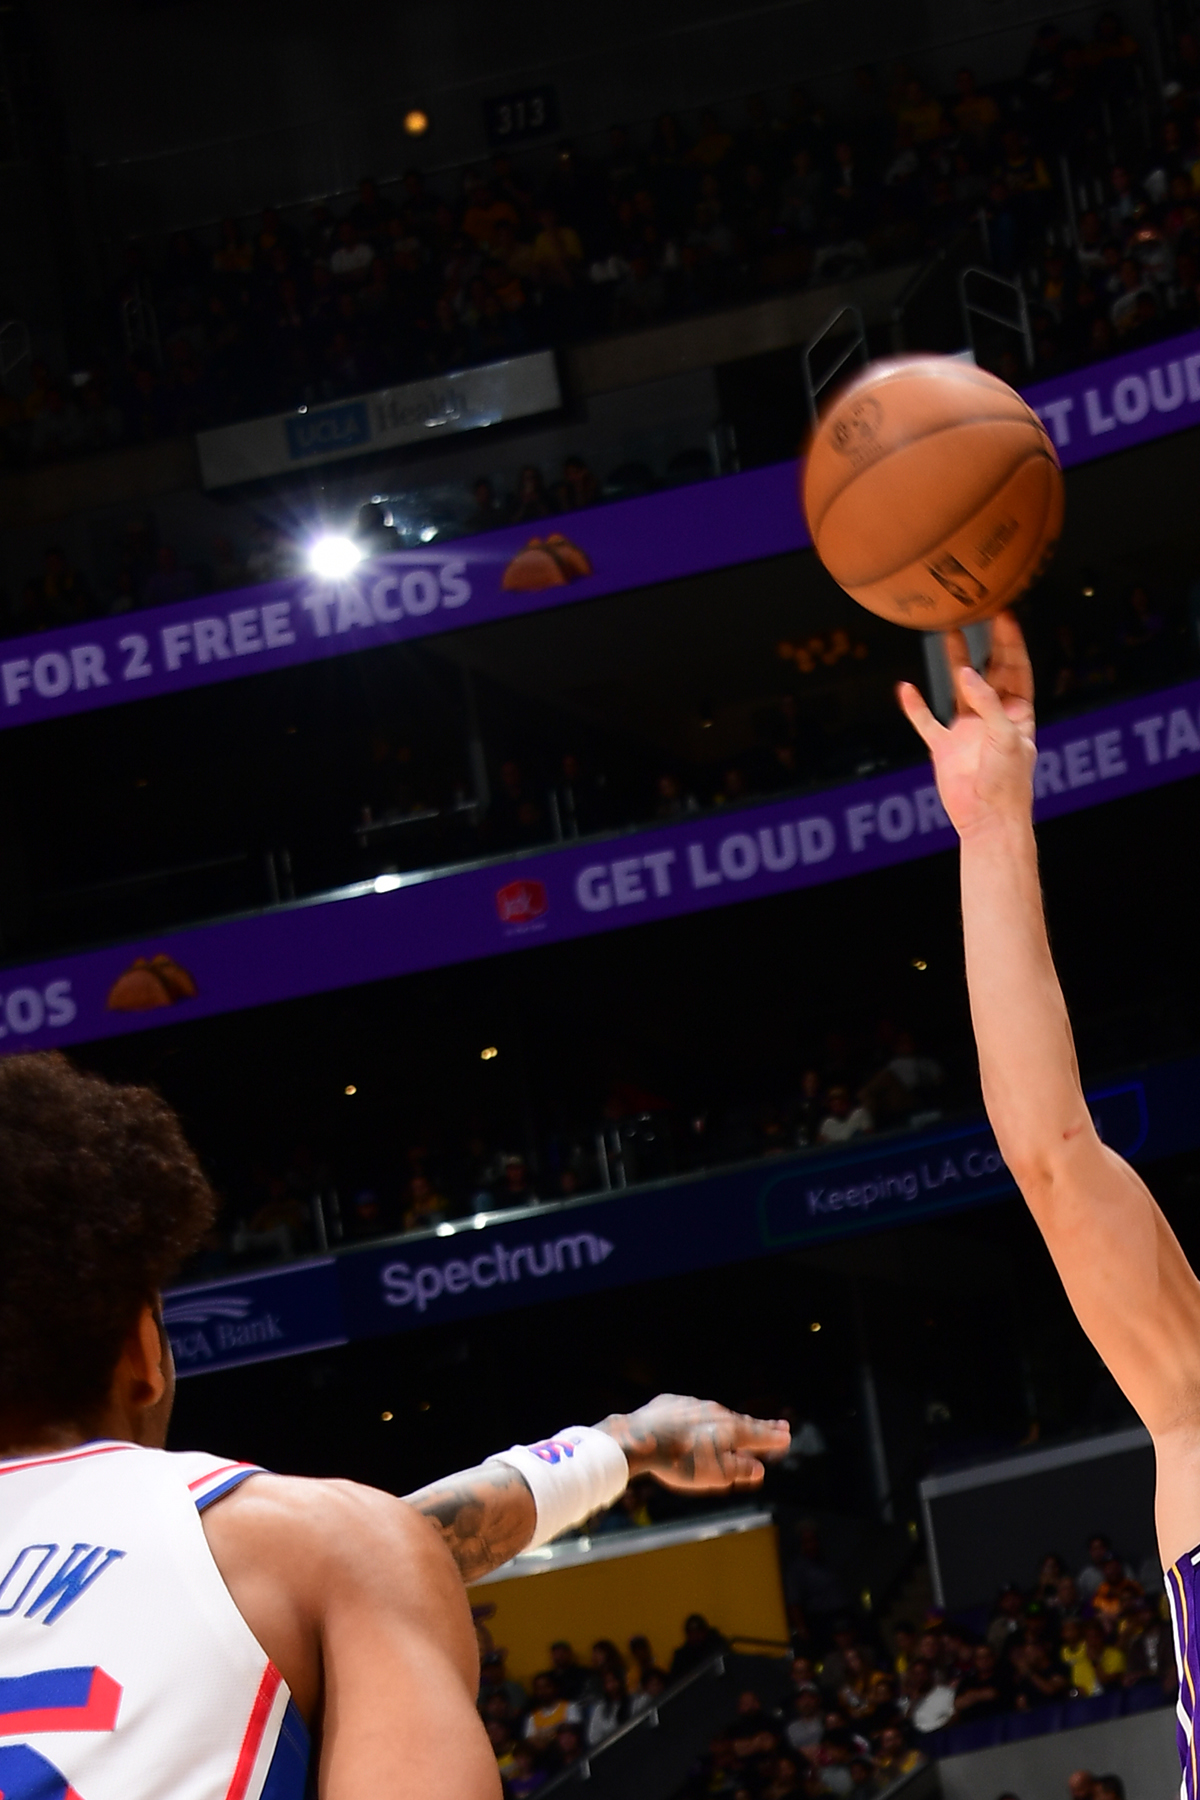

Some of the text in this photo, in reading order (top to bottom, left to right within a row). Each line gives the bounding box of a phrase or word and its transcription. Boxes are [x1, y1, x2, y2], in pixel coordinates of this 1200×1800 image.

[296, 417, 361, 447] UCLA
[0, 560, 473, 707] FOR 2 FREE TACOS
[574, 849, 676, 913] GET
[686, 815, 838, 891] LOUD
[844, 784, 953, 854] FOR
[1034, 727, 1128, 800] REE
[805, 1170, 919, 1217] Keeping
[919, 1154, 963, 1190] LA
[379, 1231, 606, 1314] Spectrum
[214, 1311, 285, 1353] Bank
